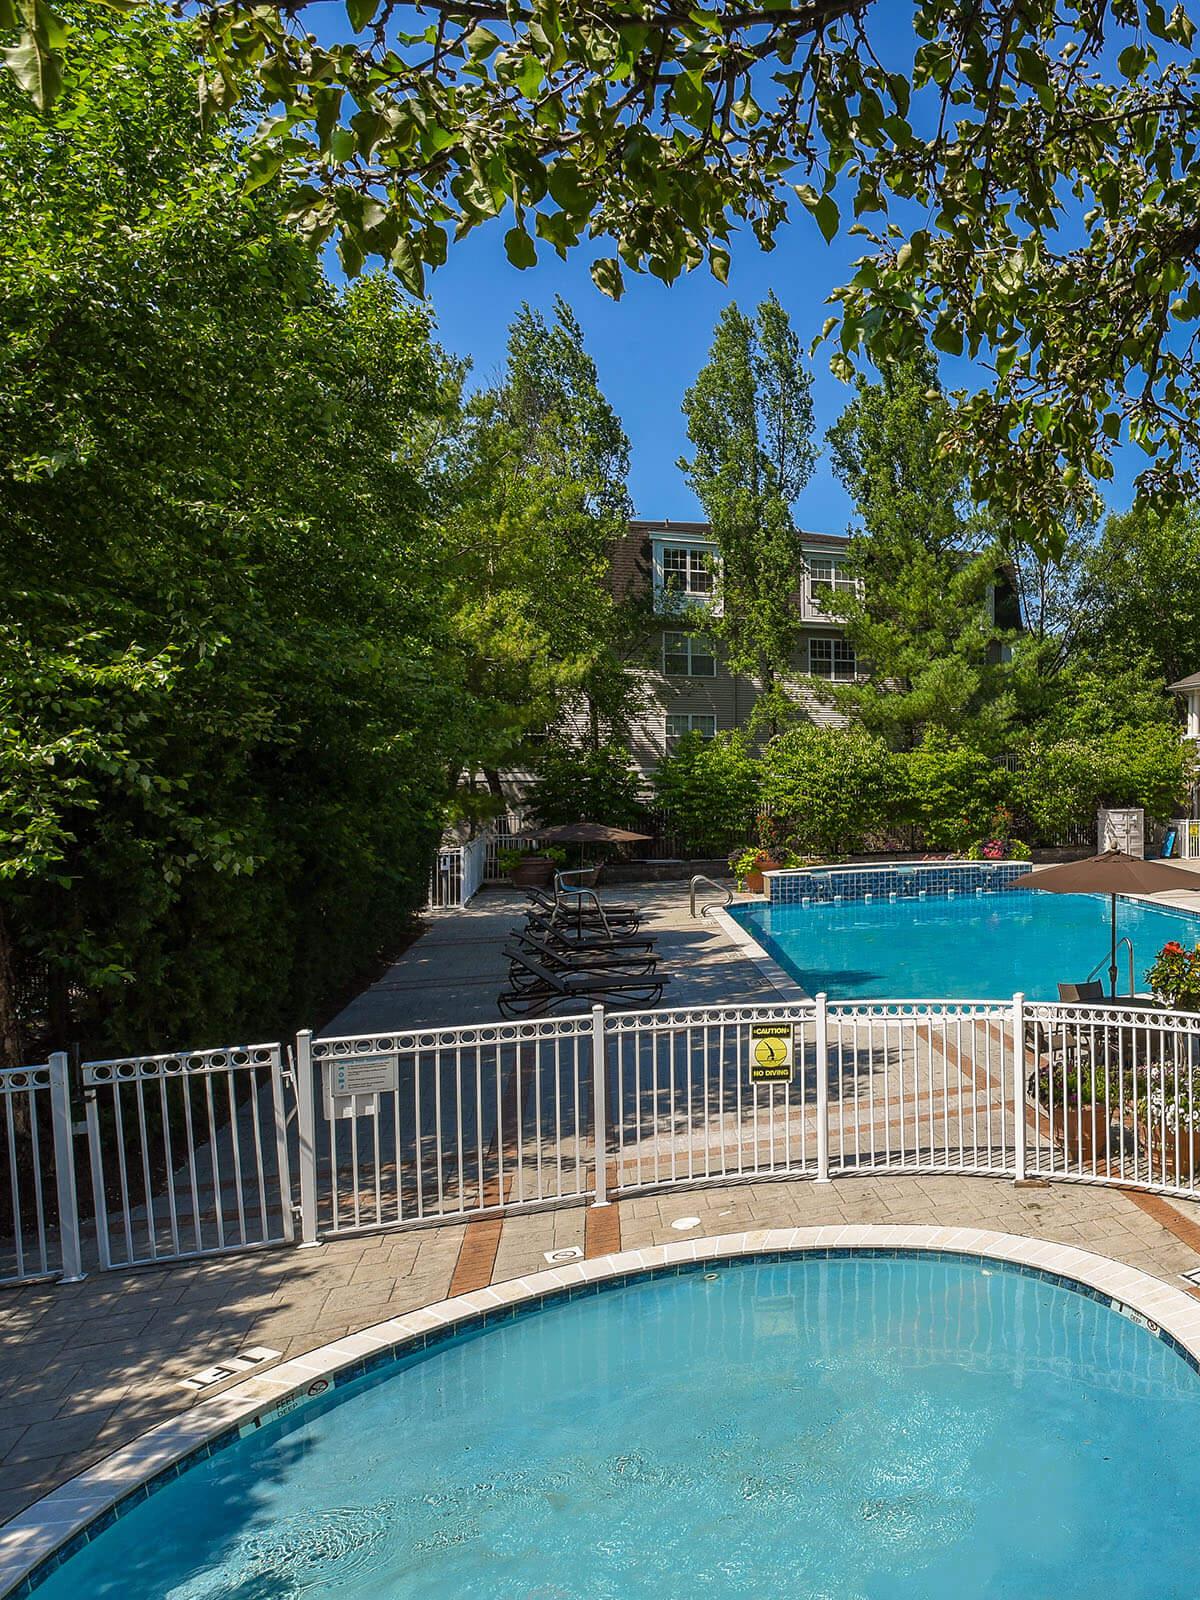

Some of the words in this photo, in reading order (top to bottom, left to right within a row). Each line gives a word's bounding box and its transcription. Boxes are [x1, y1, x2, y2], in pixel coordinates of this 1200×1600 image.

[756, 1027, 787, 1035] CAUTION
[765, 1069, 789, 1077] DIVING
[237, 1355, 265, 1363] 1
[188, 1367, 238, 1390] FT
[275, 1393, 295, 1409] FEET
[277, 1402, 298, 1417] DEEP
[248, 1411, 262, 1429] 1
